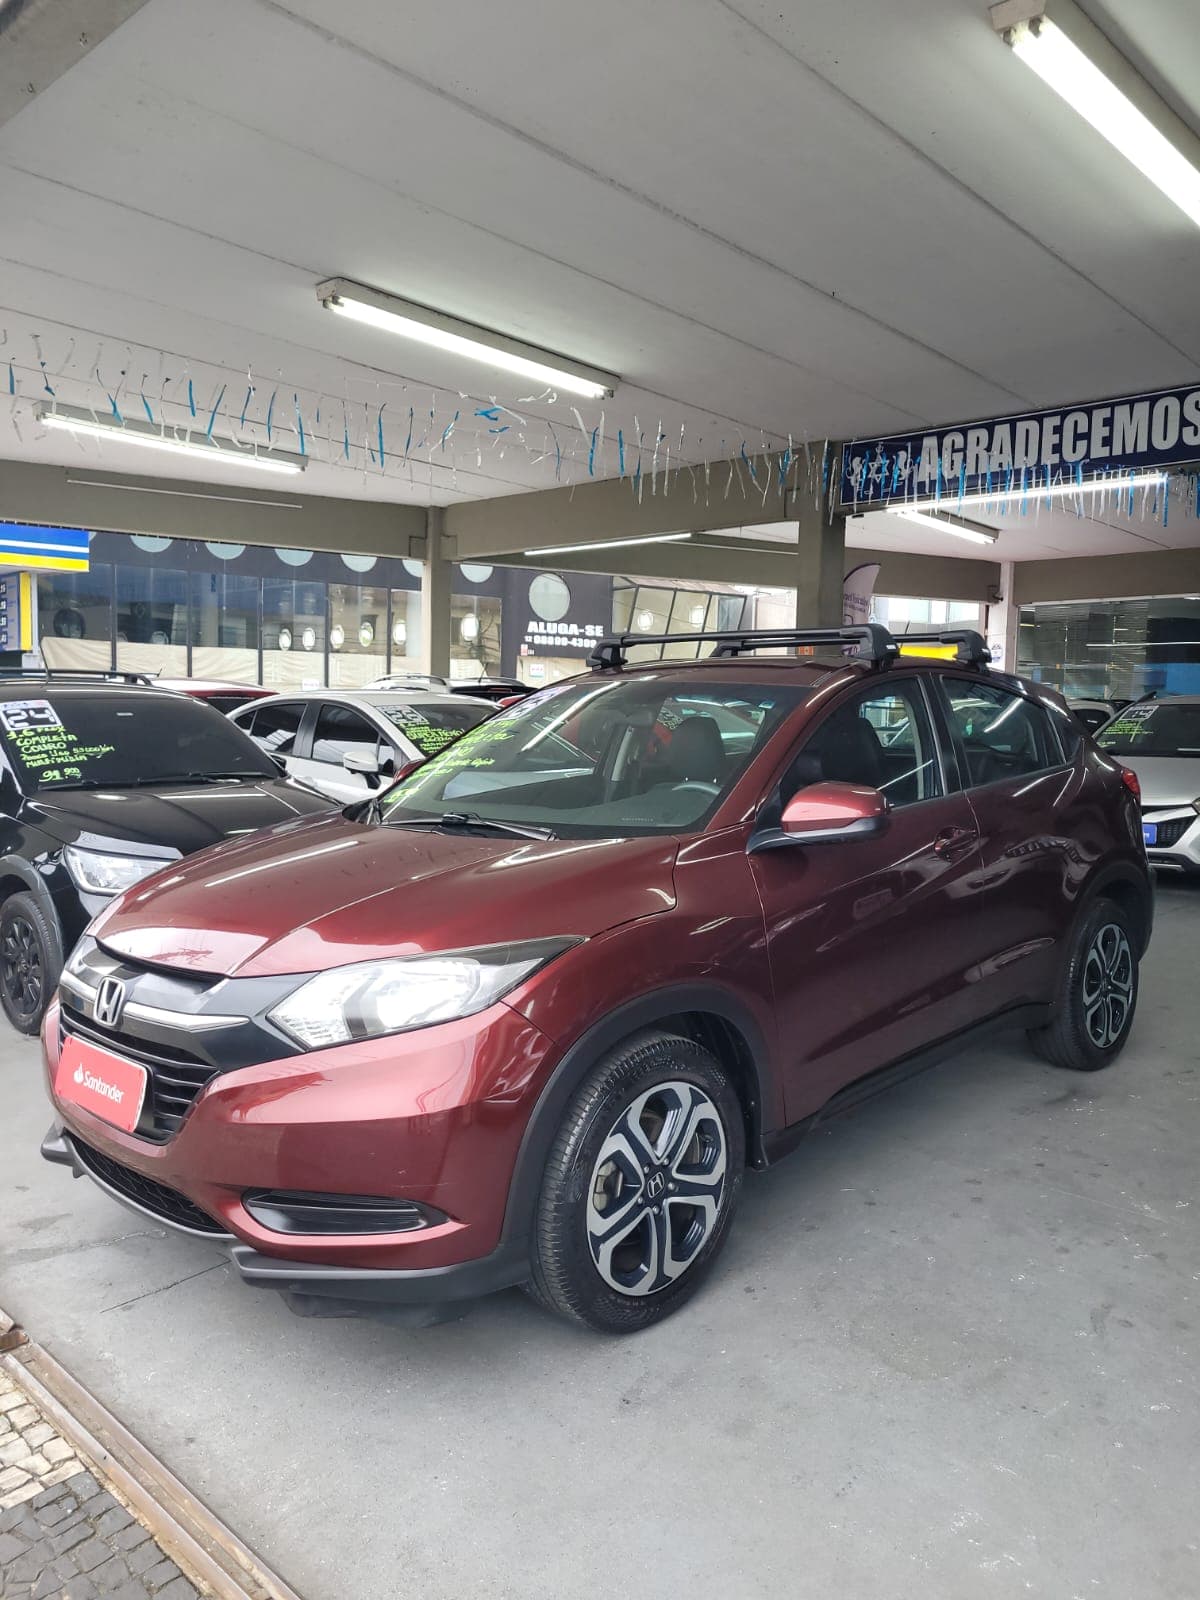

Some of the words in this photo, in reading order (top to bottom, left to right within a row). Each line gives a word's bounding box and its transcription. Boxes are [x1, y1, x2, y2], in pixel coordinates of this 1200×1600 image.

[527, 621, 604, 637] ALUGA-SE
[6, 709, 56, 728] 24
[83, 1071, 124, 1104] Santander
